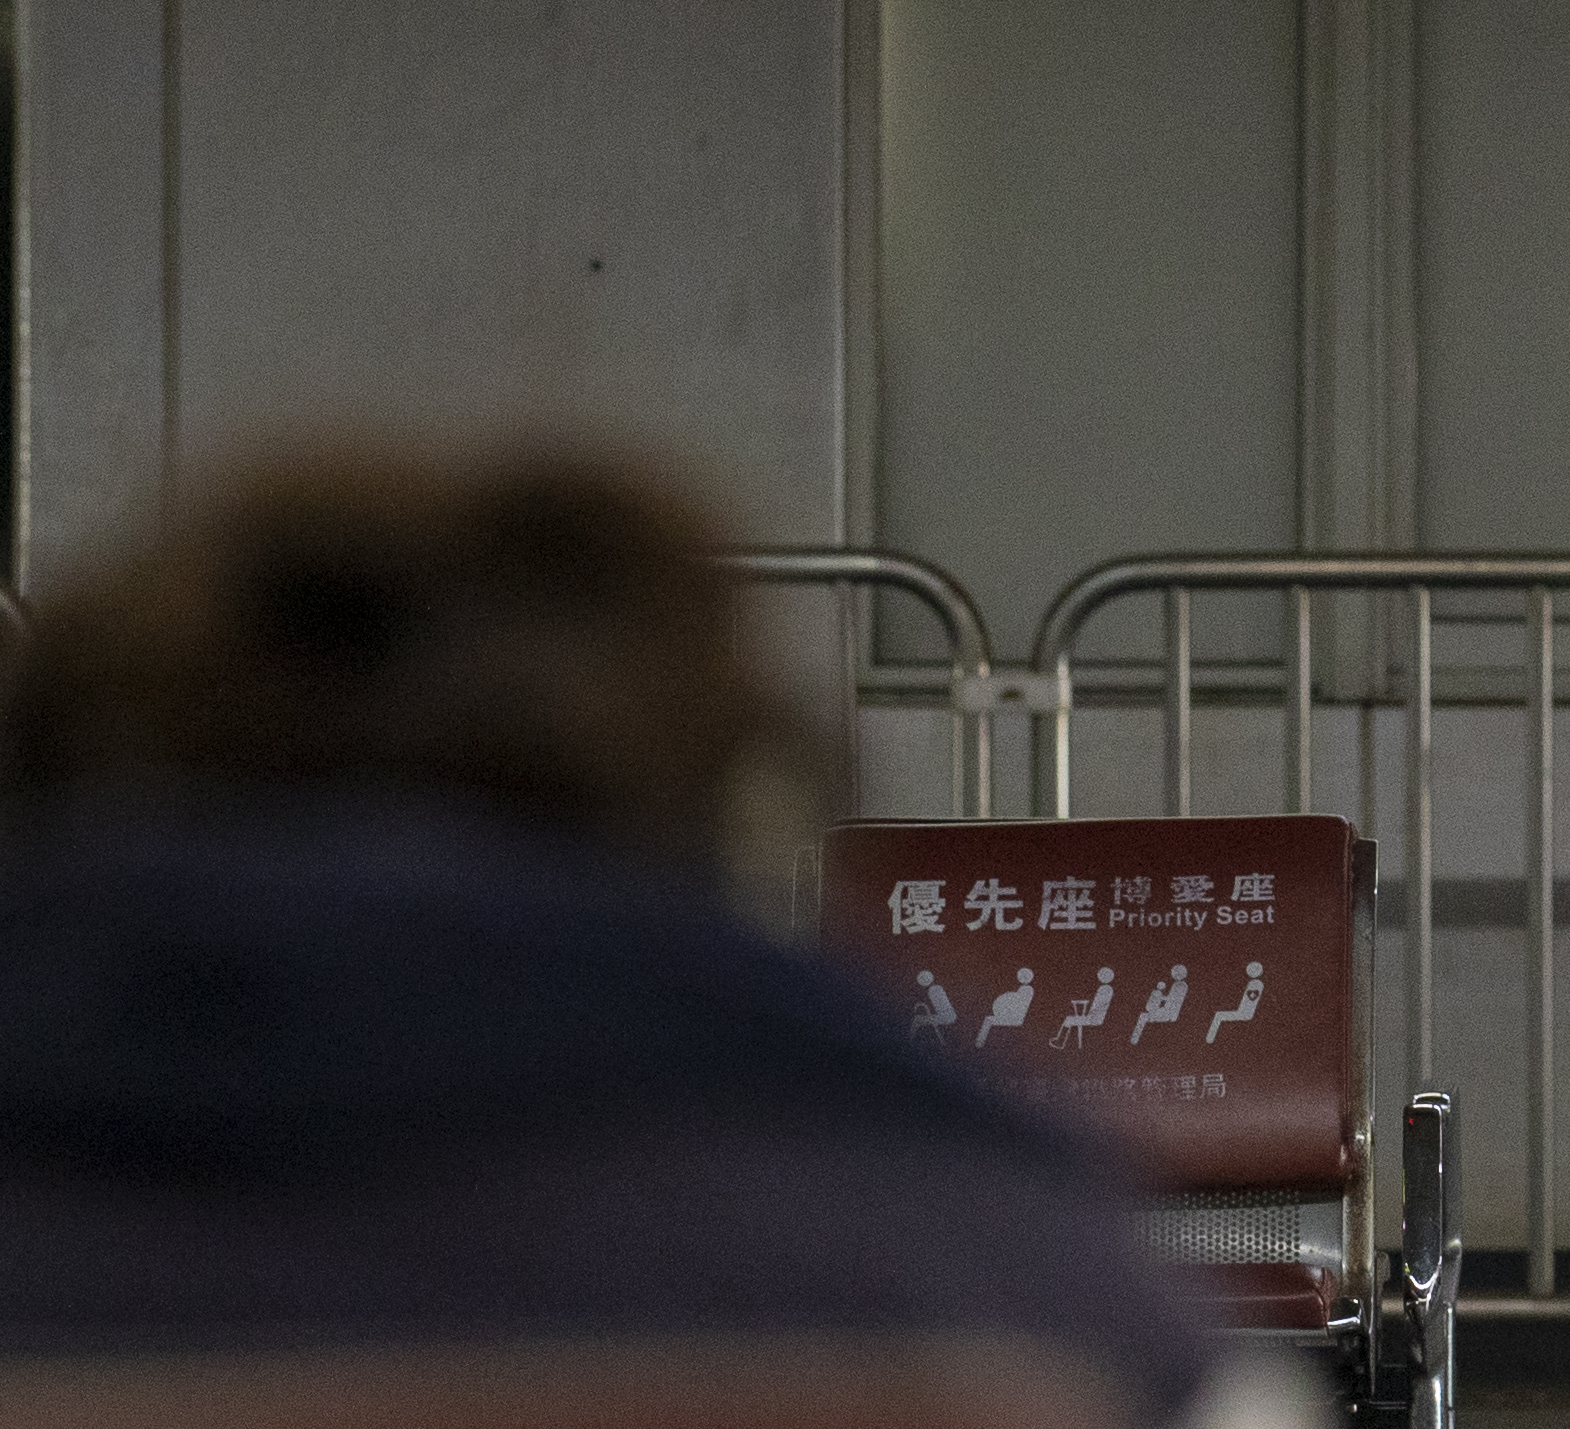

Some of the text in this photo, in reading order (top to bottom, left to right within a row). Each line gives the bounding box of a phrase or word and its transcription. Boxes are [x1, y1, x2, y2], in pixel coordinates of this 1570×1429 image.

[888, 876, 1098, 934] 優先座
[1109, 873, 1276, 905] 博愛座
[1109, 904, 1275, 931] Priority Seat
